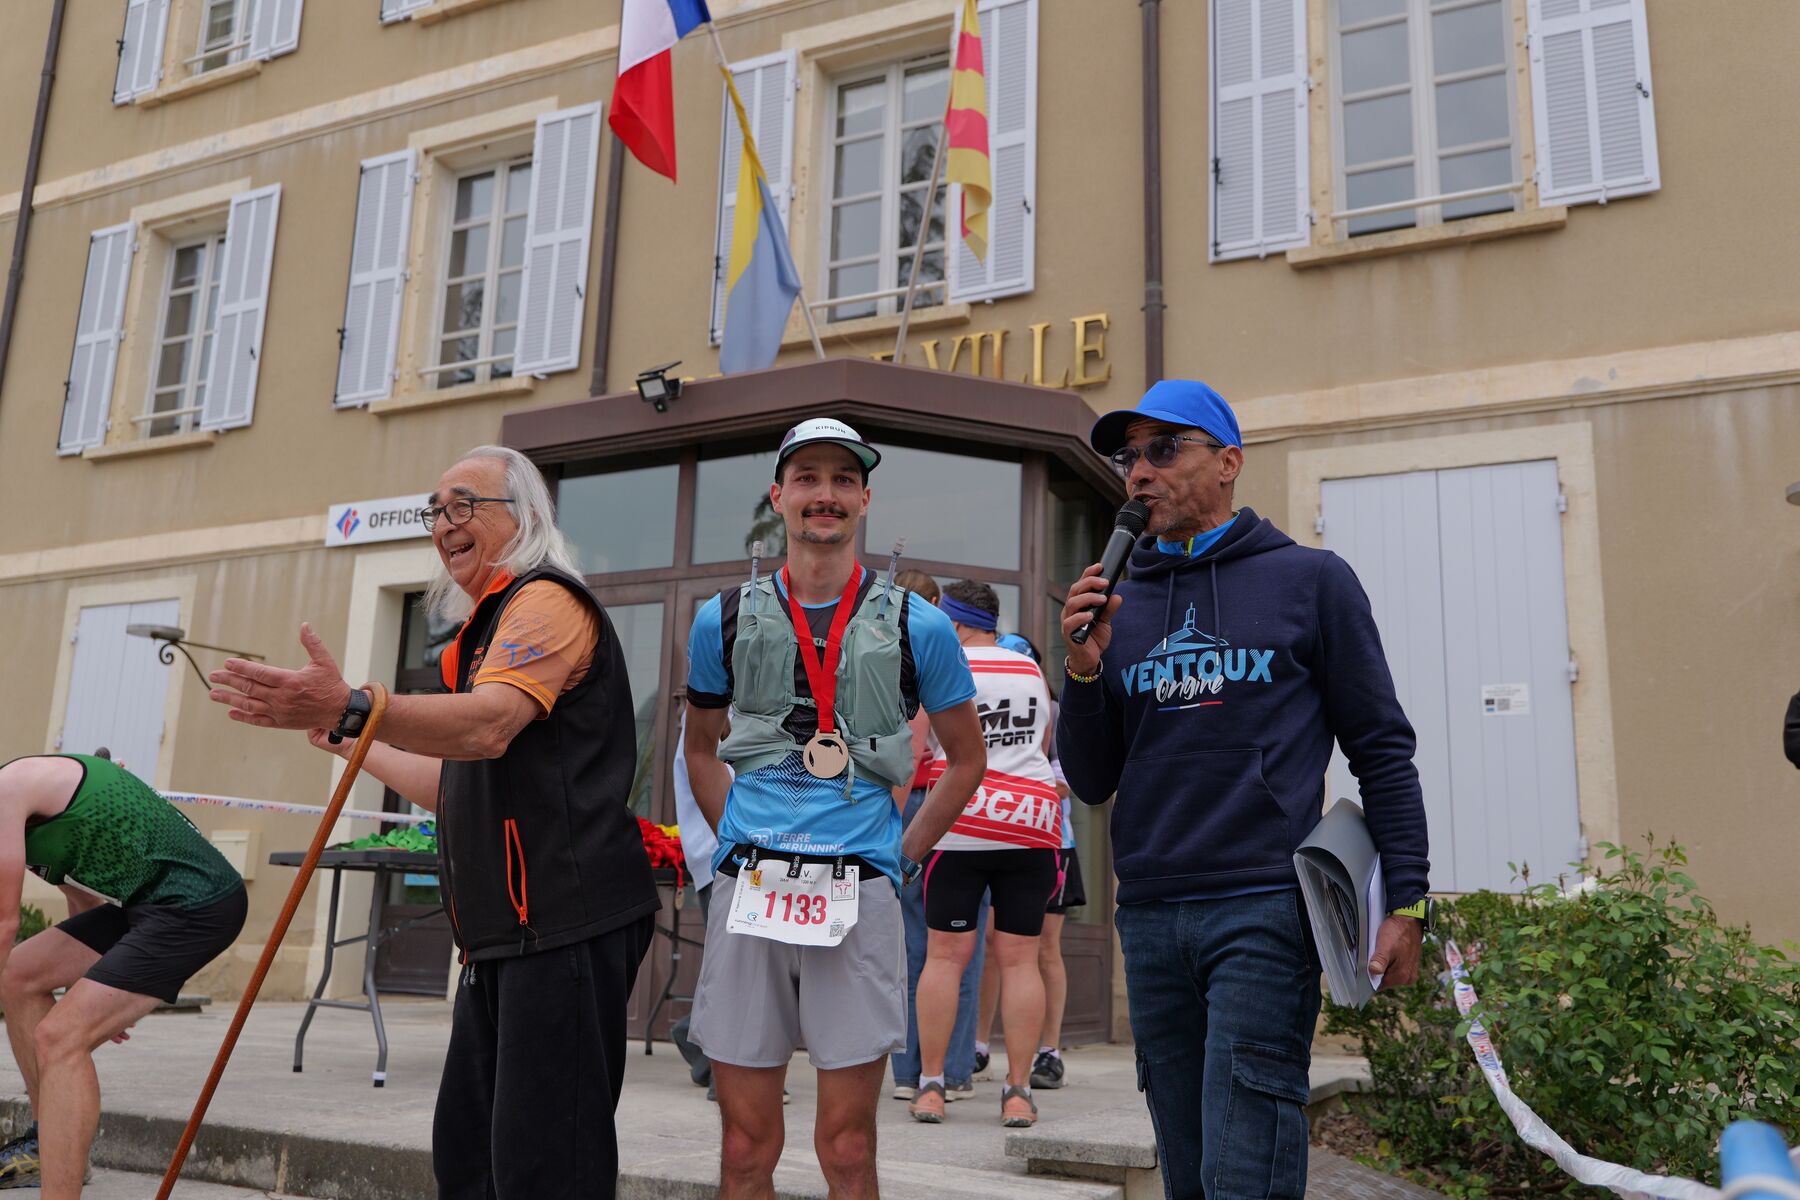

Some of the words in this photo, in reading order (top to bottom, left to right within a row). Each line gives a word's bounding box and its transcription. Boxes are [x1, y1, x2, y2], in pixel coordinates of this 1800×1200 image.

[921, 313, 1112, 389] VILLE
[815, 426, 846, 434] KIPRUN
[368, 507, 422, 528] OFFICE
[1121, 648, 1275, 697] VENTOUX
[777, 832, 811, 843] TERRE
[791, 843, 845, 853] RUNNING
[764, 890, 827, 926] 1133
